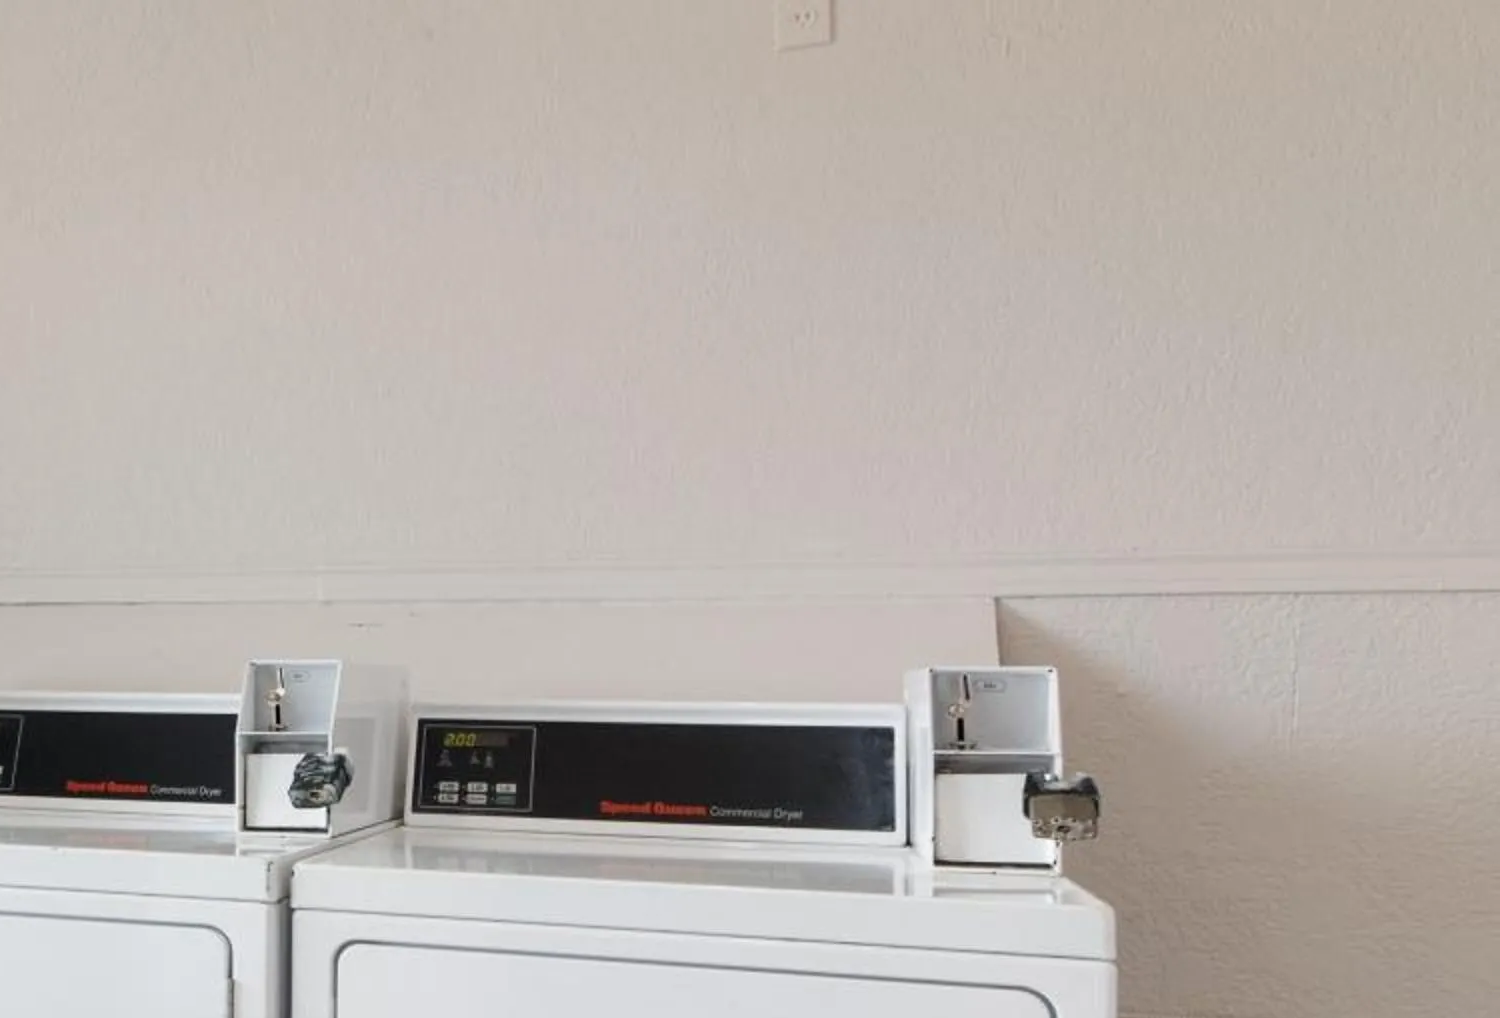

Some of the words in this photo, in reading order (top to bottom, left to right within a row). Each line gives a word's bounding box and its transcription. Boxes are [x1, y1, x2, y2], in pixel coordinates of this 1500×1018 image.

[151, 784, 199, 796] Commercial
[200, 785, 222, 797] Dryer
[600, 801, 650, 815] Speed
[653, 802, 707, 816] Queen
[709, 805, 771, 818] Commercial
[773, 807, 803, 820] Dryer
